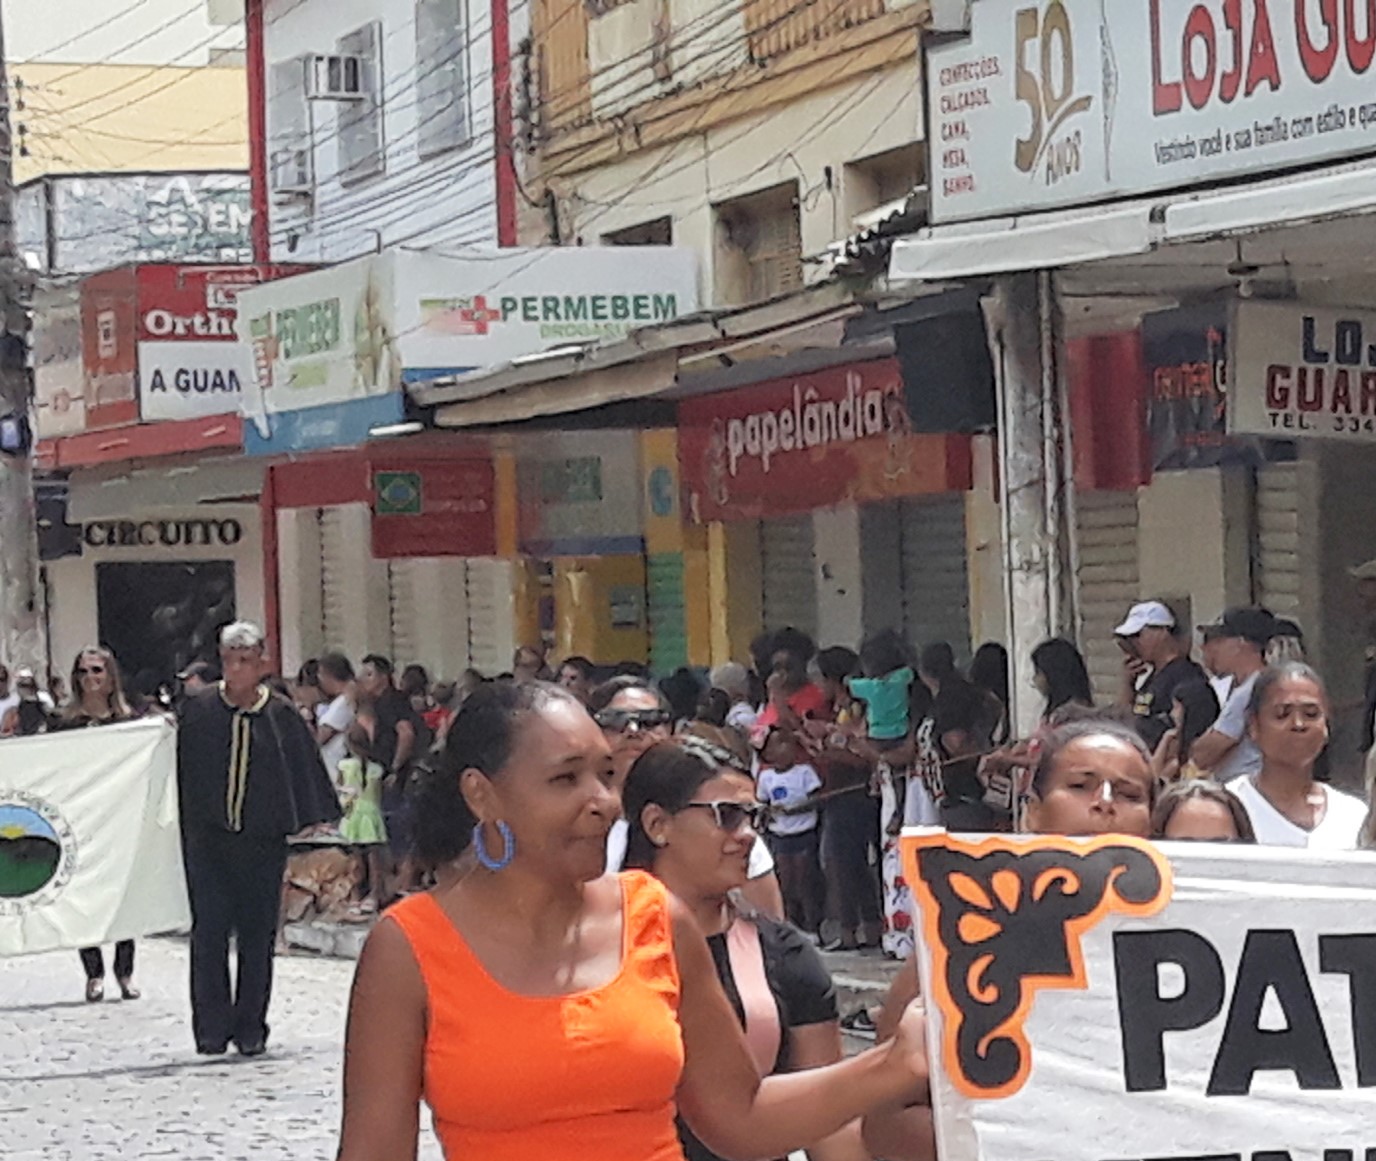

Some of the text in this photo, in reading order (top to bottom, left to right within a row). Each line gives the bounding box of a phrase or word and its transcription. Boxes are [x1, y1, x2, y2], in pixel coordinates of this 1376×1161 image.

[1149, 0, 1281, 116] LOJA
[1015, 1, 1073, 173] 50
[501, 294, 678, 321] PERMEBEM
[144, 308, 239, 336] Orth
[150, 368, 166, 393] A
[726, 370, 884, 477] papelândia
[1269, 413, 1318, 431] TEL.
[85, 518, 242, 547] CIRCUITO
